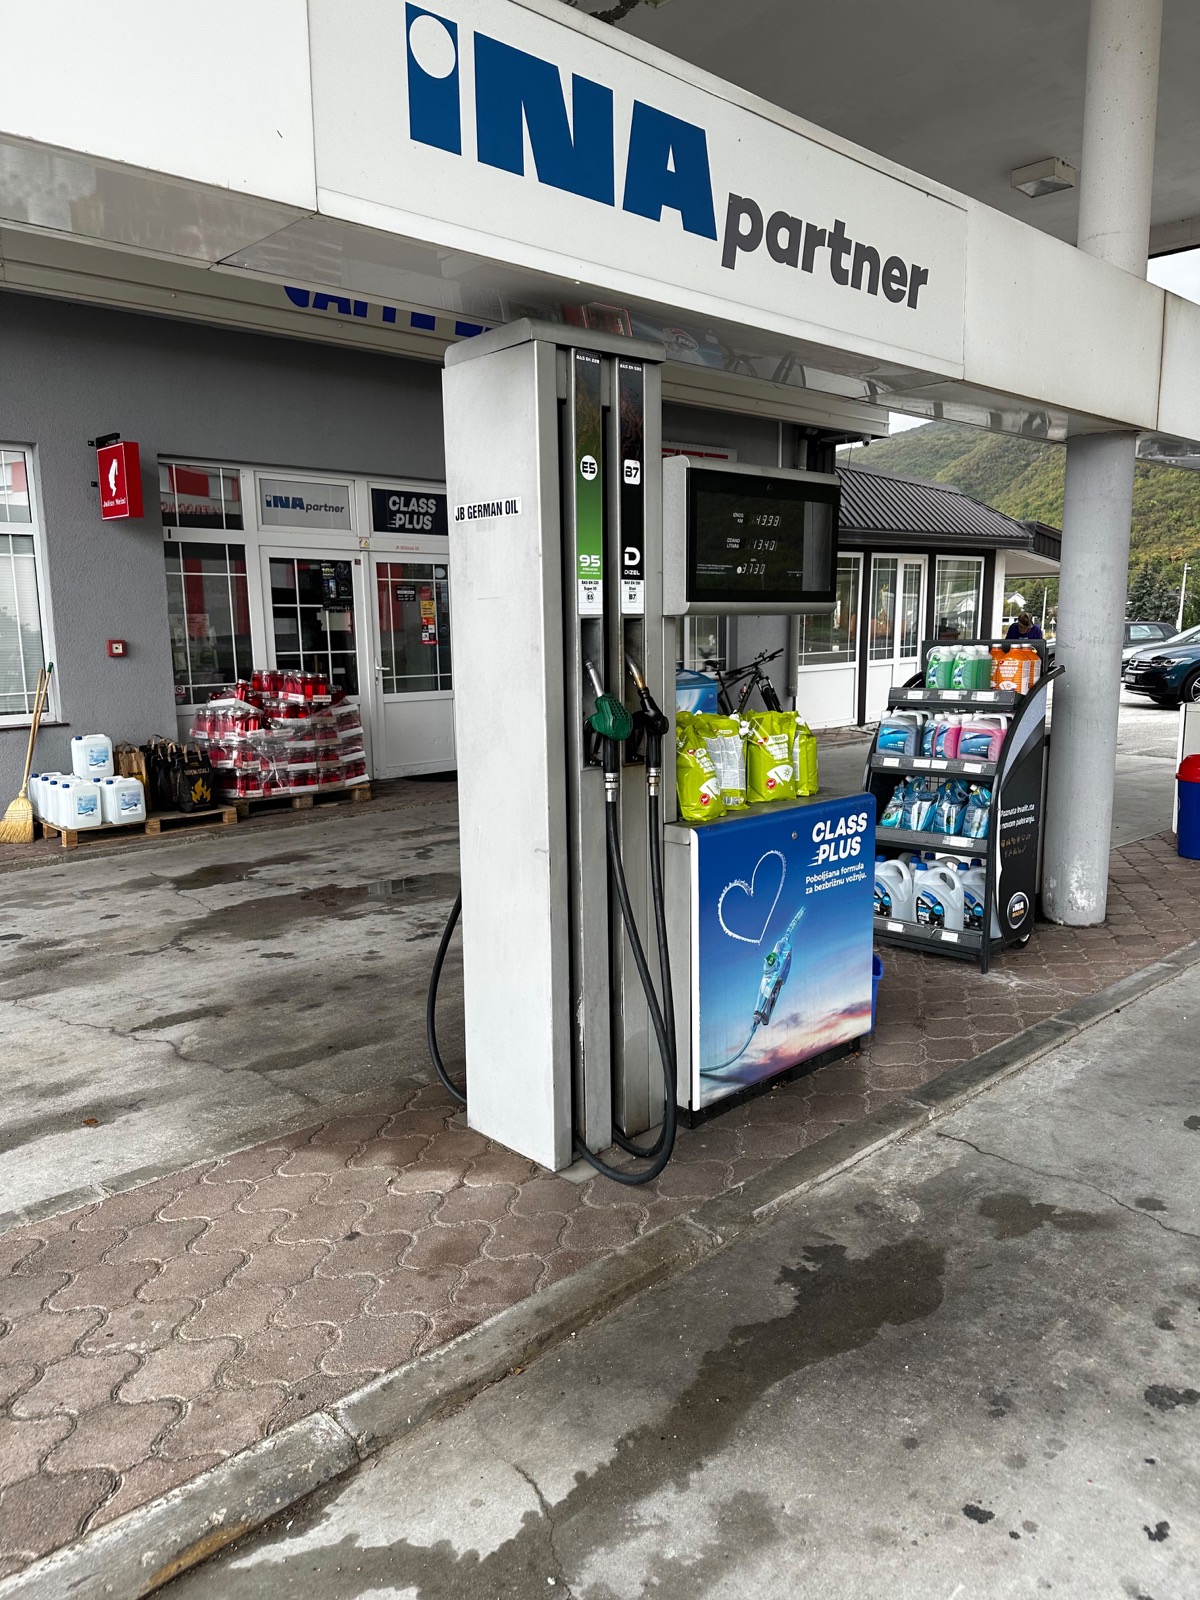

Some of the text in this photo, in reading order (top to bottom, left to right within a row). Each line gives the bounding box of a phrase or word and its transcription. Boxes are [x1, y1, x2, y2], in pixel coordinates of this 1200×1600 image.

[721, 192, 929, 310] partner
[582, 461, 596, 475] E5
[625, 466, 639, 478] B7
[305, 501, 345, 513] partner
[388, 495, 437, 514] CLASS
[455, 499, 518, 521] JB GERMAN OIL
[394, 513, 433, 530] PLUS
[579, 554, 601, 567] 95
[624, 547, 640, 565] D
[812, 812, 868, 843] CLASS
[817, 836, 862, 865] PLUS
[805, 861, 865, 885] Poboljšana formula
[805, 886, 813, 895] za
[814, 877, 845, 892] bezbrižnu
